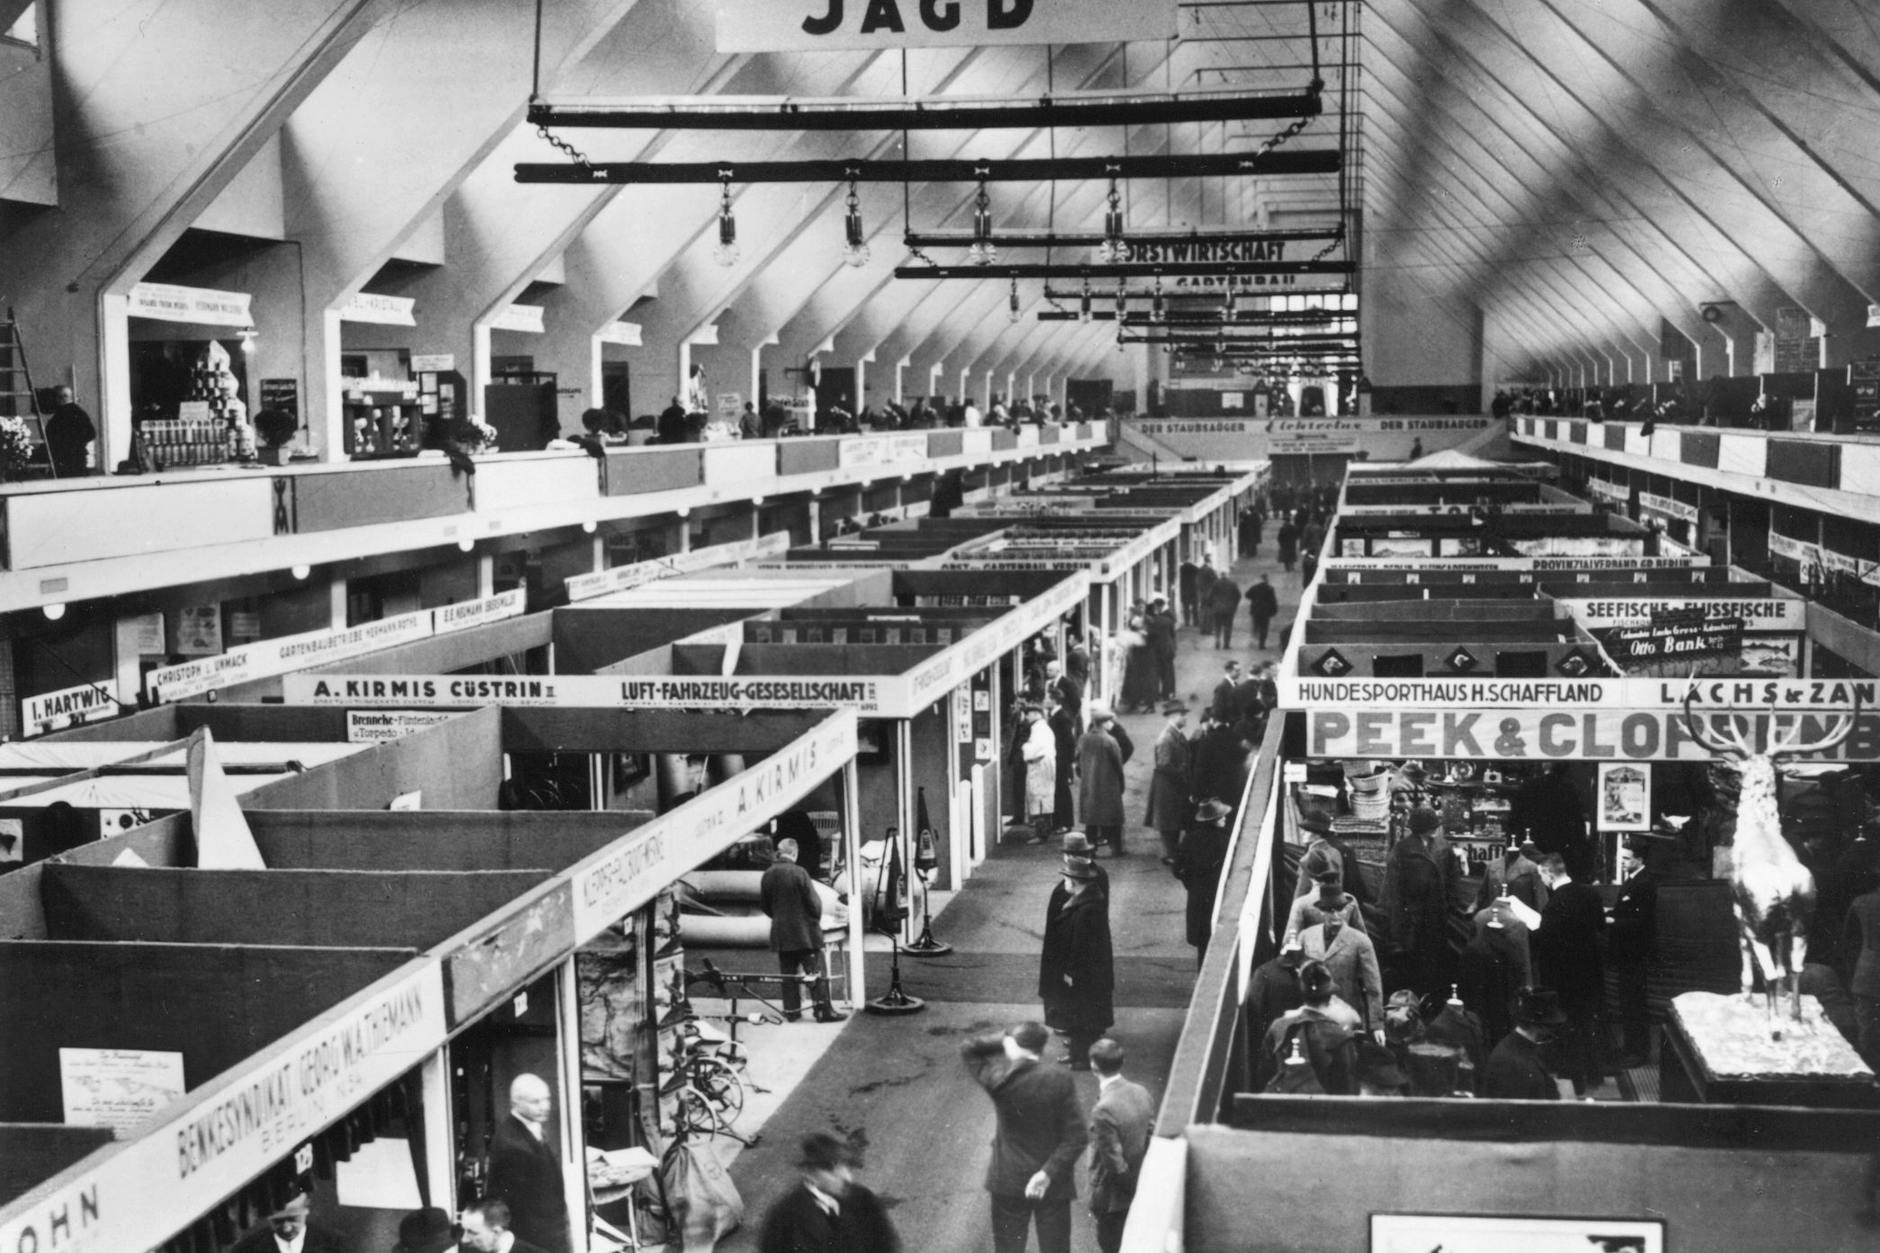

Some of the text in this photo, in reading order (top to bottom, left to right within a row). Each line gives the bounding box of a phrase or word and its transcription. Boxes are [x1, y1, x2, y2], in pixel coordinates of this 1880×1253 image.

[801, 0, 1034, 36] JAGD
[1586, 602, 1669, 618] SEEFISCHE
[1630, 635, 1706, 656] Otto Bank
[346, 680, 437, 698] KIRMIS
[450, 680, 542, 698] CÜSTRIN
[1298, 683, 1467, 702] HUNDESPORTHAUS
[1660, 682, 1778, 704] LACHS
[44, 685, 111, 718] HARTWIG
[1313, 711, 1486, 757] PEEK
[1493, 717, 1528, 758] &
